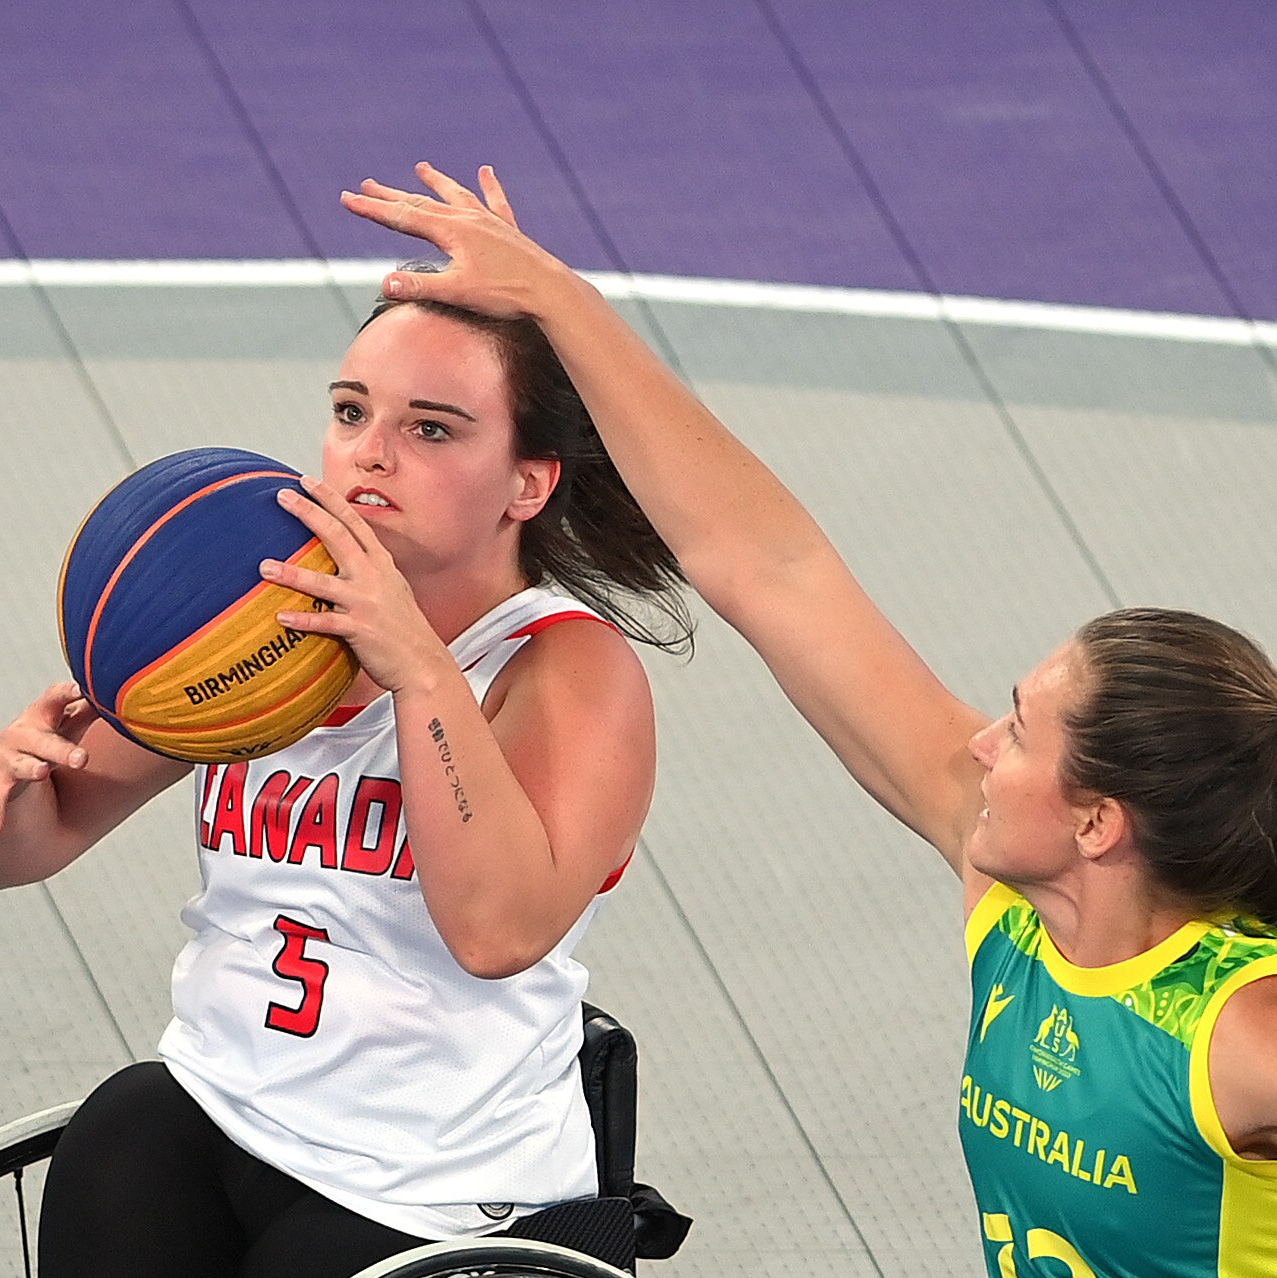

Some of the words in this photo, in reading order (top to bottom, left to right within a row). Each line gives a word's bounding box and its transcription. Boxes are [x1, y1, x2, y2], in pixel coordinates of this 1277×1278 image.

[183, 627, 310, 705] BIRMINGHA
[265, 914, 332, 1039] 5
[961, 1074, 1138, 1195] AUSTRALIA
